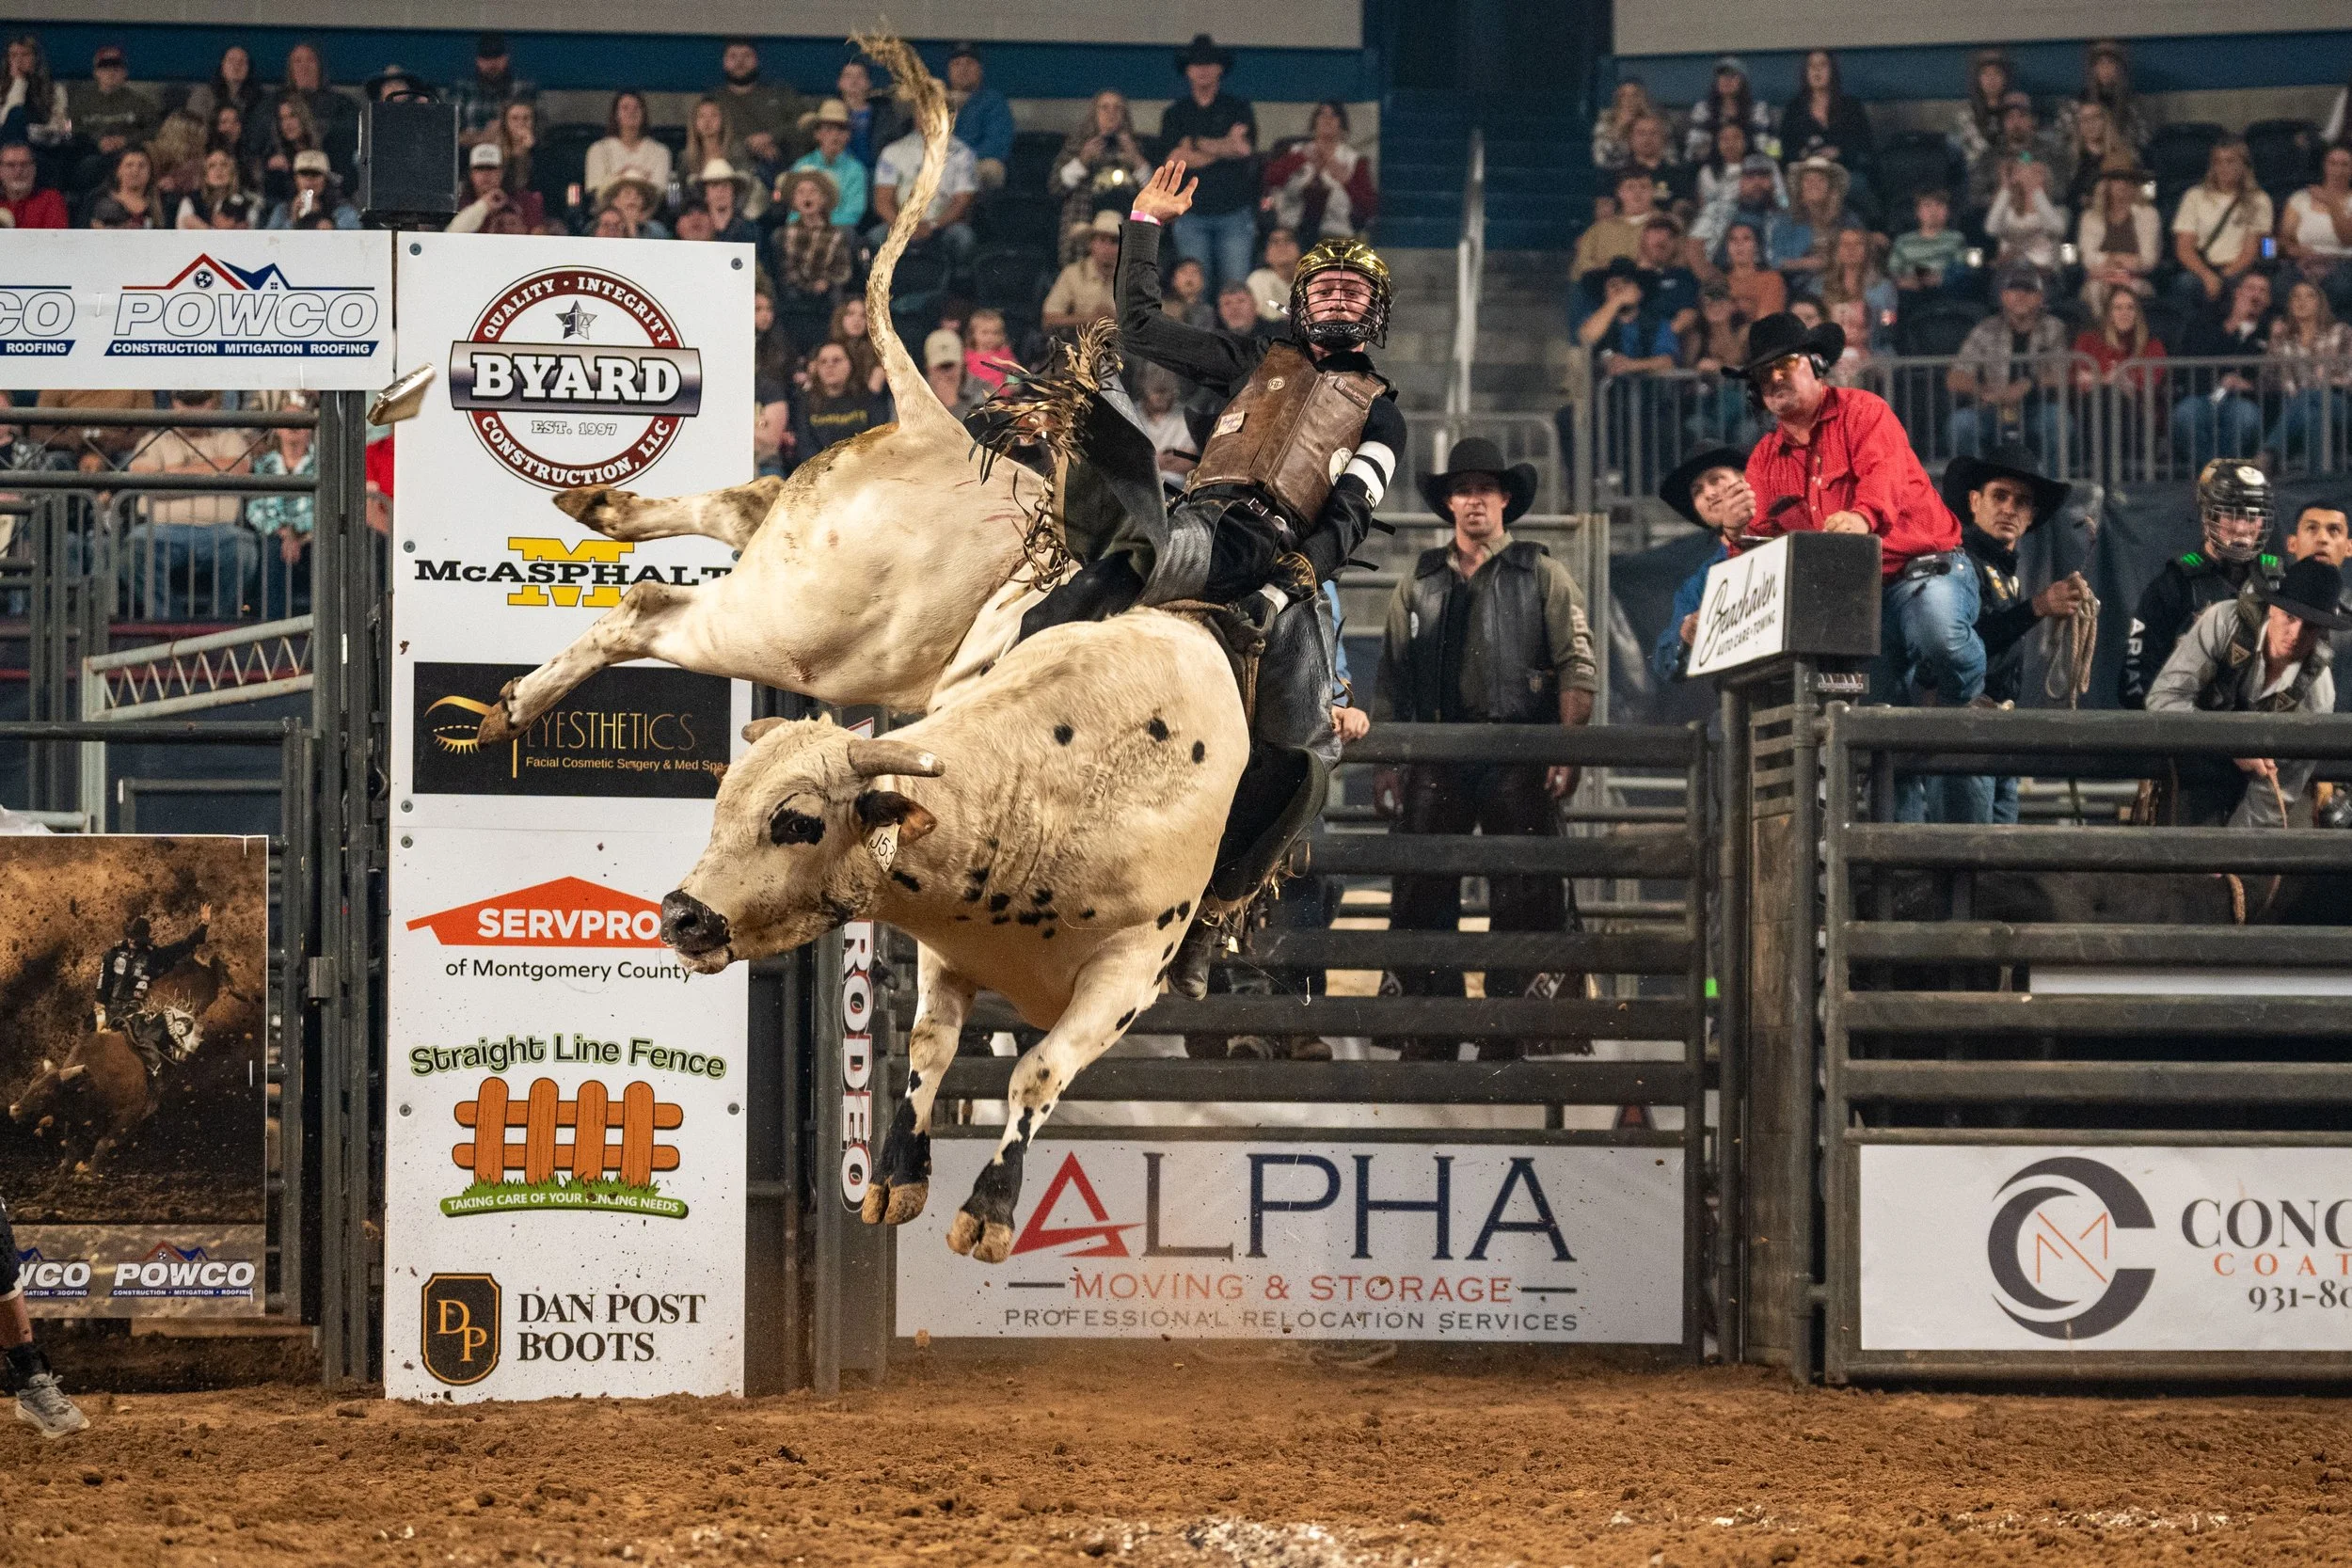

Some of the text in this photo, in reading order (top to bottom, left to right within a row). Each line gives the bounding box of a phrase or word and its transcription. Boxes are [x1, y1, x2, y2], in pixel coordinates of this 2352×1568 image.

[114, 293, 378, 337] POWCO
[484, 277, 674, 343] QUALITY INTEGRITY
[6, 342, 67, 354] ROOFING
[113, 343, 370, 355] CONSTRUCTION MITIGATION ROOFING
[471, 354, 682, 404] BYARD
[532, 420, 617, 436] EST. 1997
[481, 416, 670, 485] CONSTRUCTION, LLC
[526, 756, 559, 768] Facial
[563, 757, 613, 769] Cosmetic
[662, 759, 672, 770] &
[675, 759, 699, 770] Med
[702, 760, 723, 773] Spa
[869, 833, 896, 865] J53
[477, 908, 661, 940] SERVPRO
[446, 958, 691, 983] of Montgomery County
[410, 1034, 726, 1078] Straight Line Fence
[841, 919, 873, 1212] RODEO
[449, 1193, 678, 1212] TAKING CARE OF YOUR NCING NEEDS
[1009, 1150, 1578, 1263] ALPHA
[2181, 1198, 2352, 1249] CONC
[114, 1262, 256, 1287] POWCO
[2214, 1252, 2352, 1276] COAT
[1075, 1273, 1512, 1303] MOVING & STORAGE
[516, 1293, 706, 1324] DAN POST
[1006, 1308, 1578, 1332] PROFESSIONAL RELOCATION SERVICES
[516, 1332, 655, 1362] BOOTS
